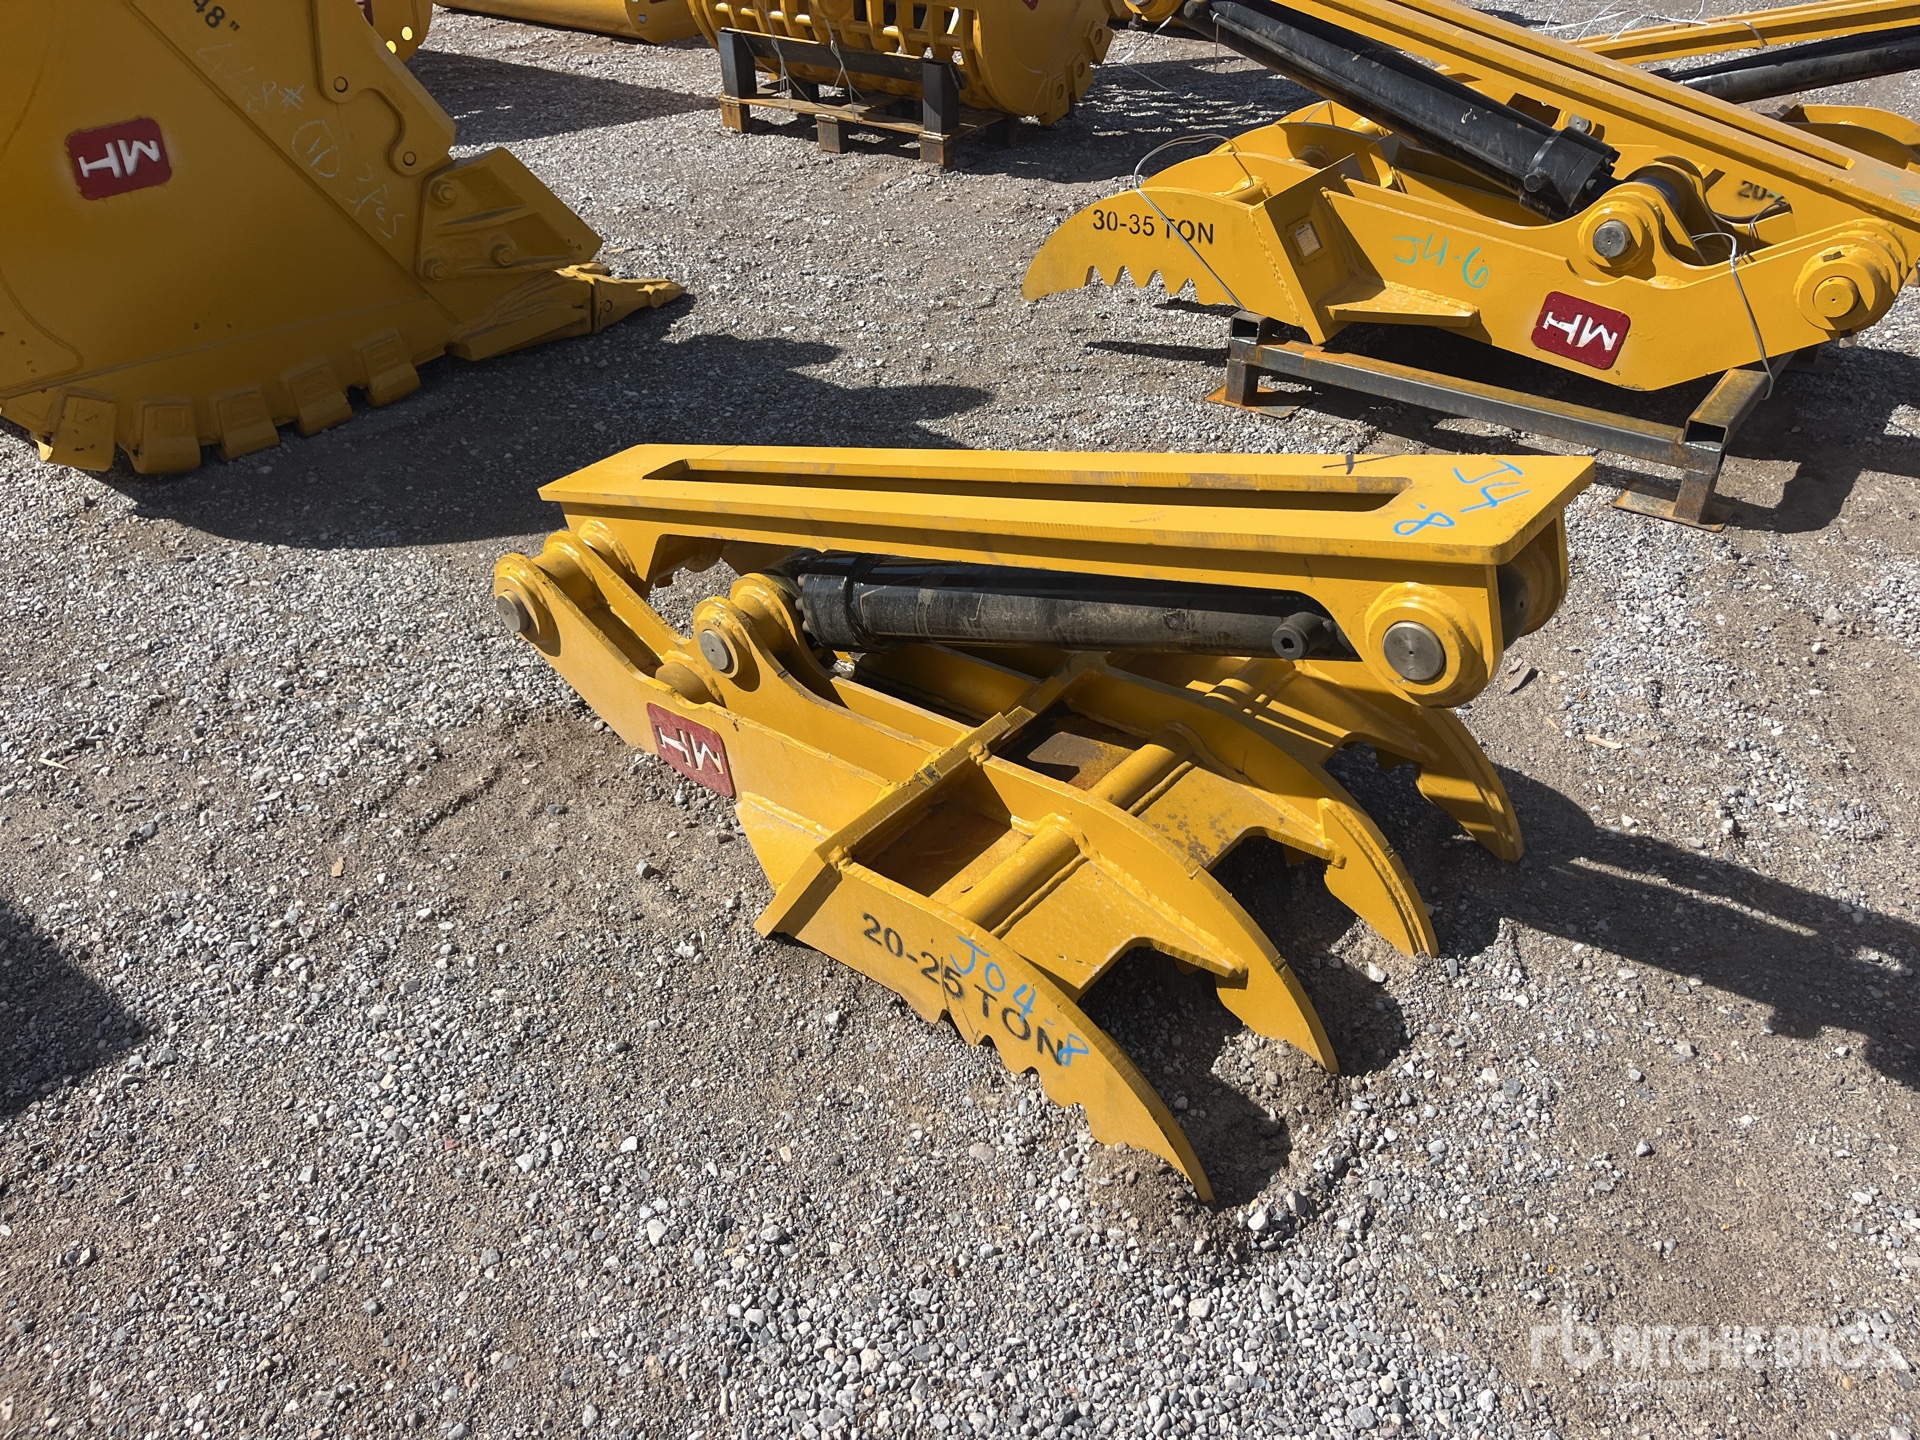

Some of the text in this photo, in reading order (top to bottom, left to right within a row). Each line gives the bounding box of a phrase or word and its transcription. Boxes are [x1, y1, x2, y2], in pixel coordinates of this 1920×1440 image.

[1093, 209, 1214, 245] 30-35 TON
[863, 913, 1065, 1066] 20-25 TON
